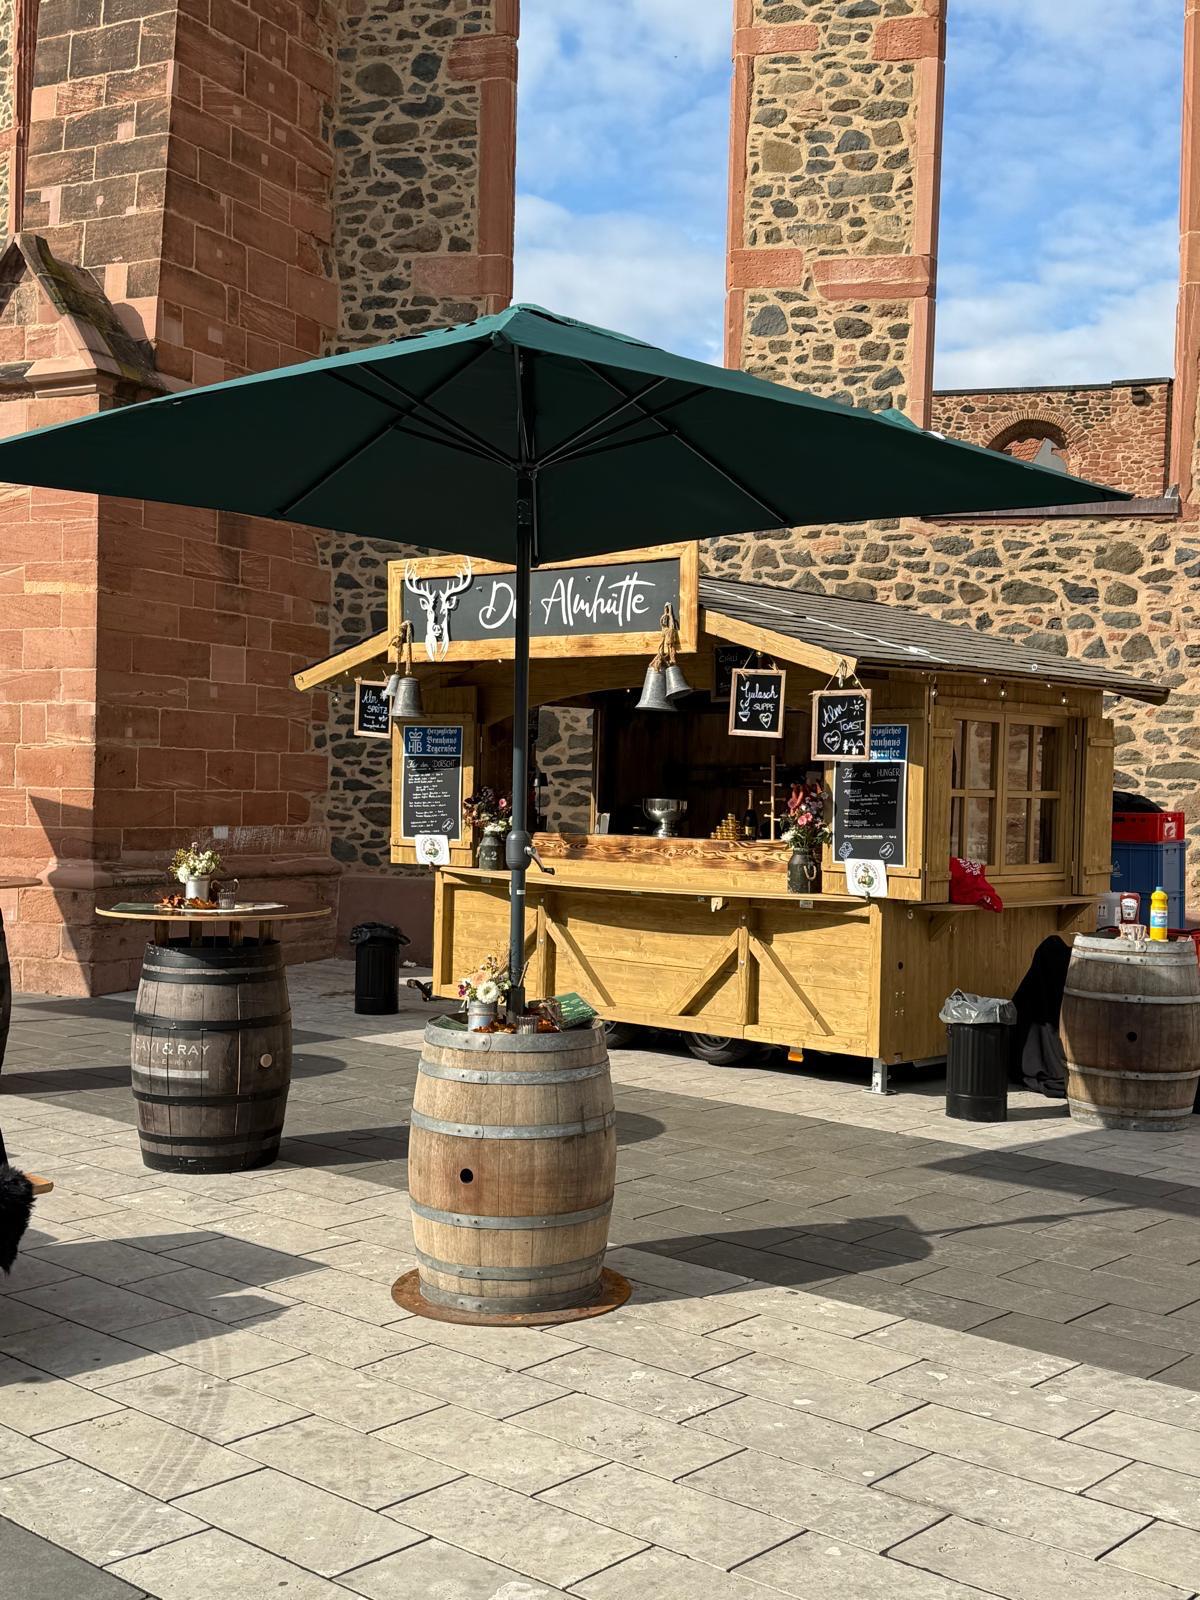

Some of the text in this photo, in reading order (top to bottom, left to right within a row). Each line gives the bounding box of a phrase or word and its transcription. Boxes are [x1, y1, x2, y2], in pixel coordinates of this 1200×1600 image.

[541, 571, 656, 627] Almhütte
[752, 702, 775, 712] SUPPE
[821, 701, 848, 727] Alm
[836, 718, 865, 731] TOAST
[870, 737, 901, 748] rauhaus
[876, 767, 901, 777] HUNGER
[162, 1042, 174, 1055] &
[177, 1045, 210, 1056] RAY
